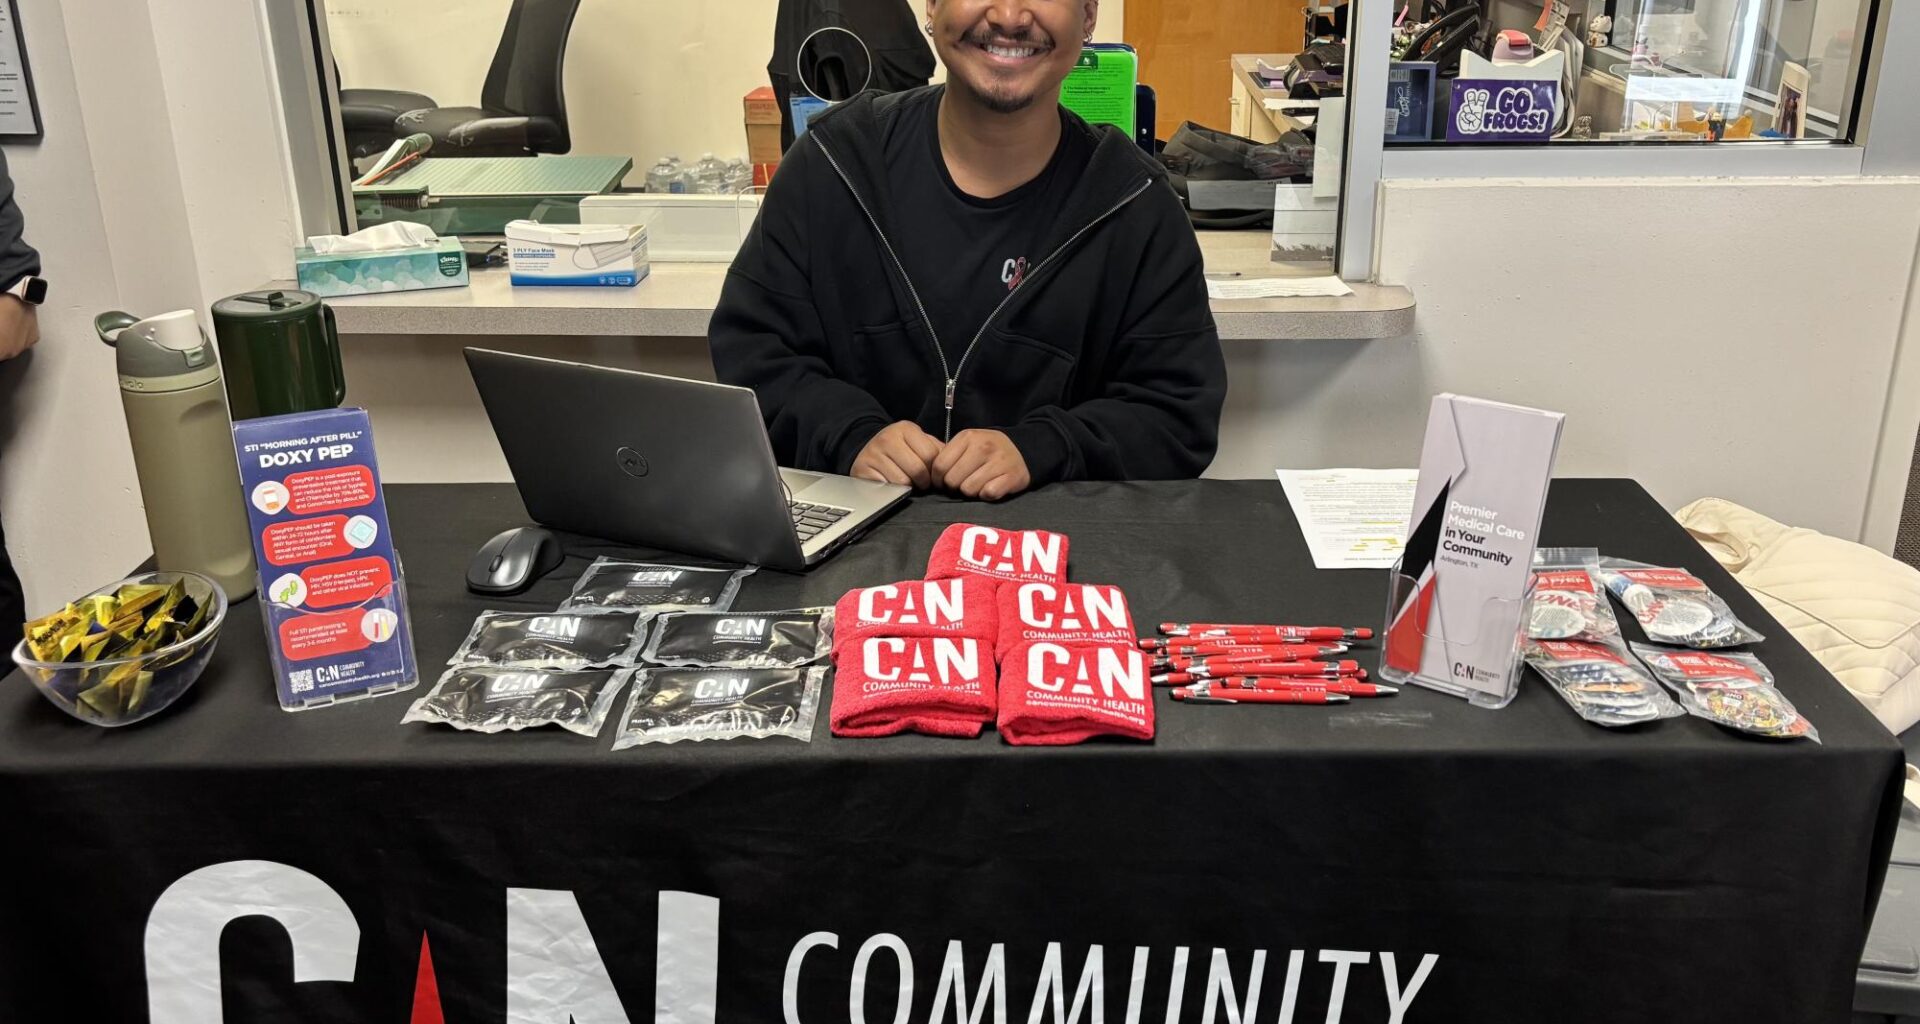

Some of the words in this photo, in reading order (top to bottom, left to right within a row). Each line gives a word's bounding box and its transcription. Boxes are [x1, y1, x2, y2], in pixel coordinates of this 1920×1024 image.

[1498, 89, 1531, 114] GO
[1483, 111, 1547, 131] FROGS!
[310, 434, 338, 444] AFTER
[259, 448, 313, 468] DOXY
[318, 444, 353, 461] PEP
[1450, 500, 1498, 520] Premier
[1445, 526, 1456, 538] in
[1458, 529, 1486, 544] Your
[1448, 514, 1494, 534] Medical
[1496, 524, 1525, 540] Care
[960, 526, 1061, 574] CAN
[1443, 540, 1512, 566] Community
[633, 571, 683, 582] CAN
[957, 560, 1016, 578] COMMUNITY
[1020, 574, 1056, 583] HEALTH
[858, 578, 964, 625] CAN
[1018, 582, 1128, 630] CAN
[528, 617, 582, 638] CAN
[715, 619, 766, 636] CAN
[1023, 630, 1087, 639] COMMUNITY
[1092, 630, 1130, 639] HEALTH
[863, 637, 978, 684] CAN
[1027, 642, 1144, 700] CAN
[1454, 662, 1474, 680] CAN
[492, 674, 549, 692] CAN
[694, 678, 750, 698] CAN
[863, 682, 934, 692] COMMUNITY
[1026, 690, 1098, 705] COMMUNITY
[1104, 700, 1145, 715] HEALTH
[782, 931, 1440, 1024] COMMUNITY
